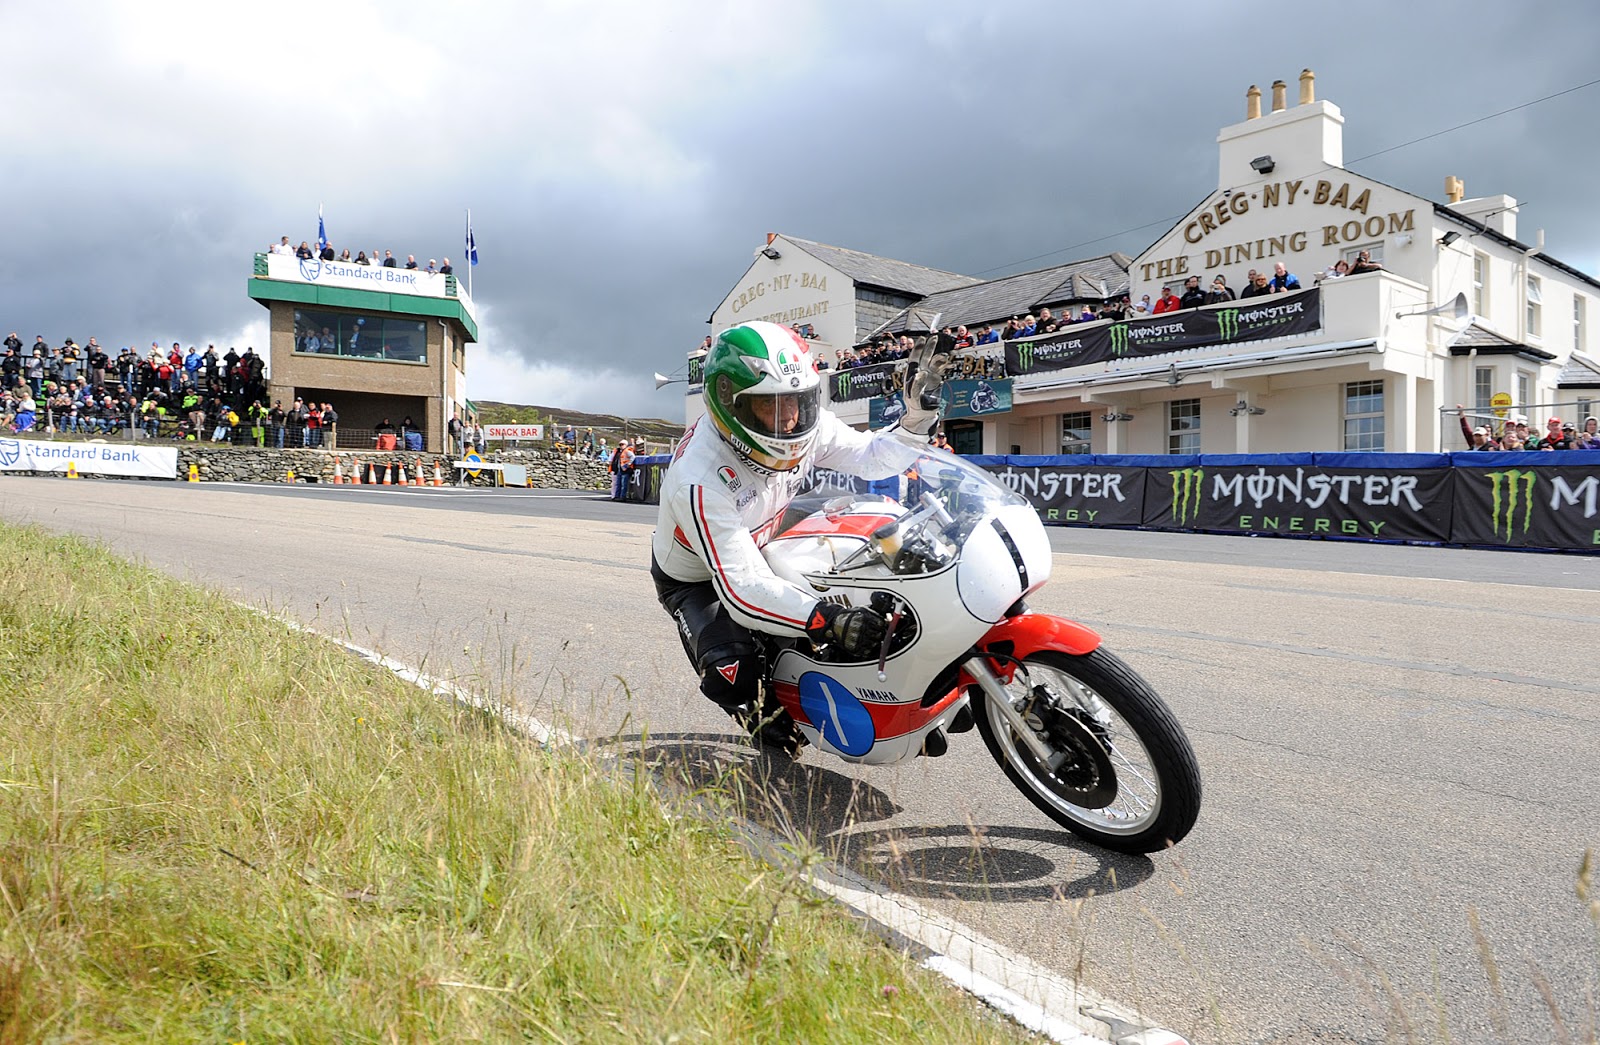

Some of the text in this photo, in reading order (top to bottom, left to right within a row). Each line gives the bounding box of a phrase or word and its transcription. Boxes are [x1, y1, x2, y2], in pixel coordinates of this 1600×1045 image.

[1140, 209, 1415, 281] THE DINING ROOM
[325, 264, 417, 284] Standard Bank
[1238, 302, 1304, 323] MONSTER
[1128, 323, 1185, 339] MONSTER
[1033, 339, 1082, 356] MONSTER
[489, 428, 538, 437] SNACK BAR
[25, 443, 140, 462] Standard Bank
[802, 466, 857, 494] NSTER
[990, 467, 1126, 502] ONSTER
[1212, 467, 1423, 512] MONSTER
[1240, 515, 1386, 535] ENERGY
[855, 687, 899, 702] YAMAHA
[818, 681, 849, 747] 1
